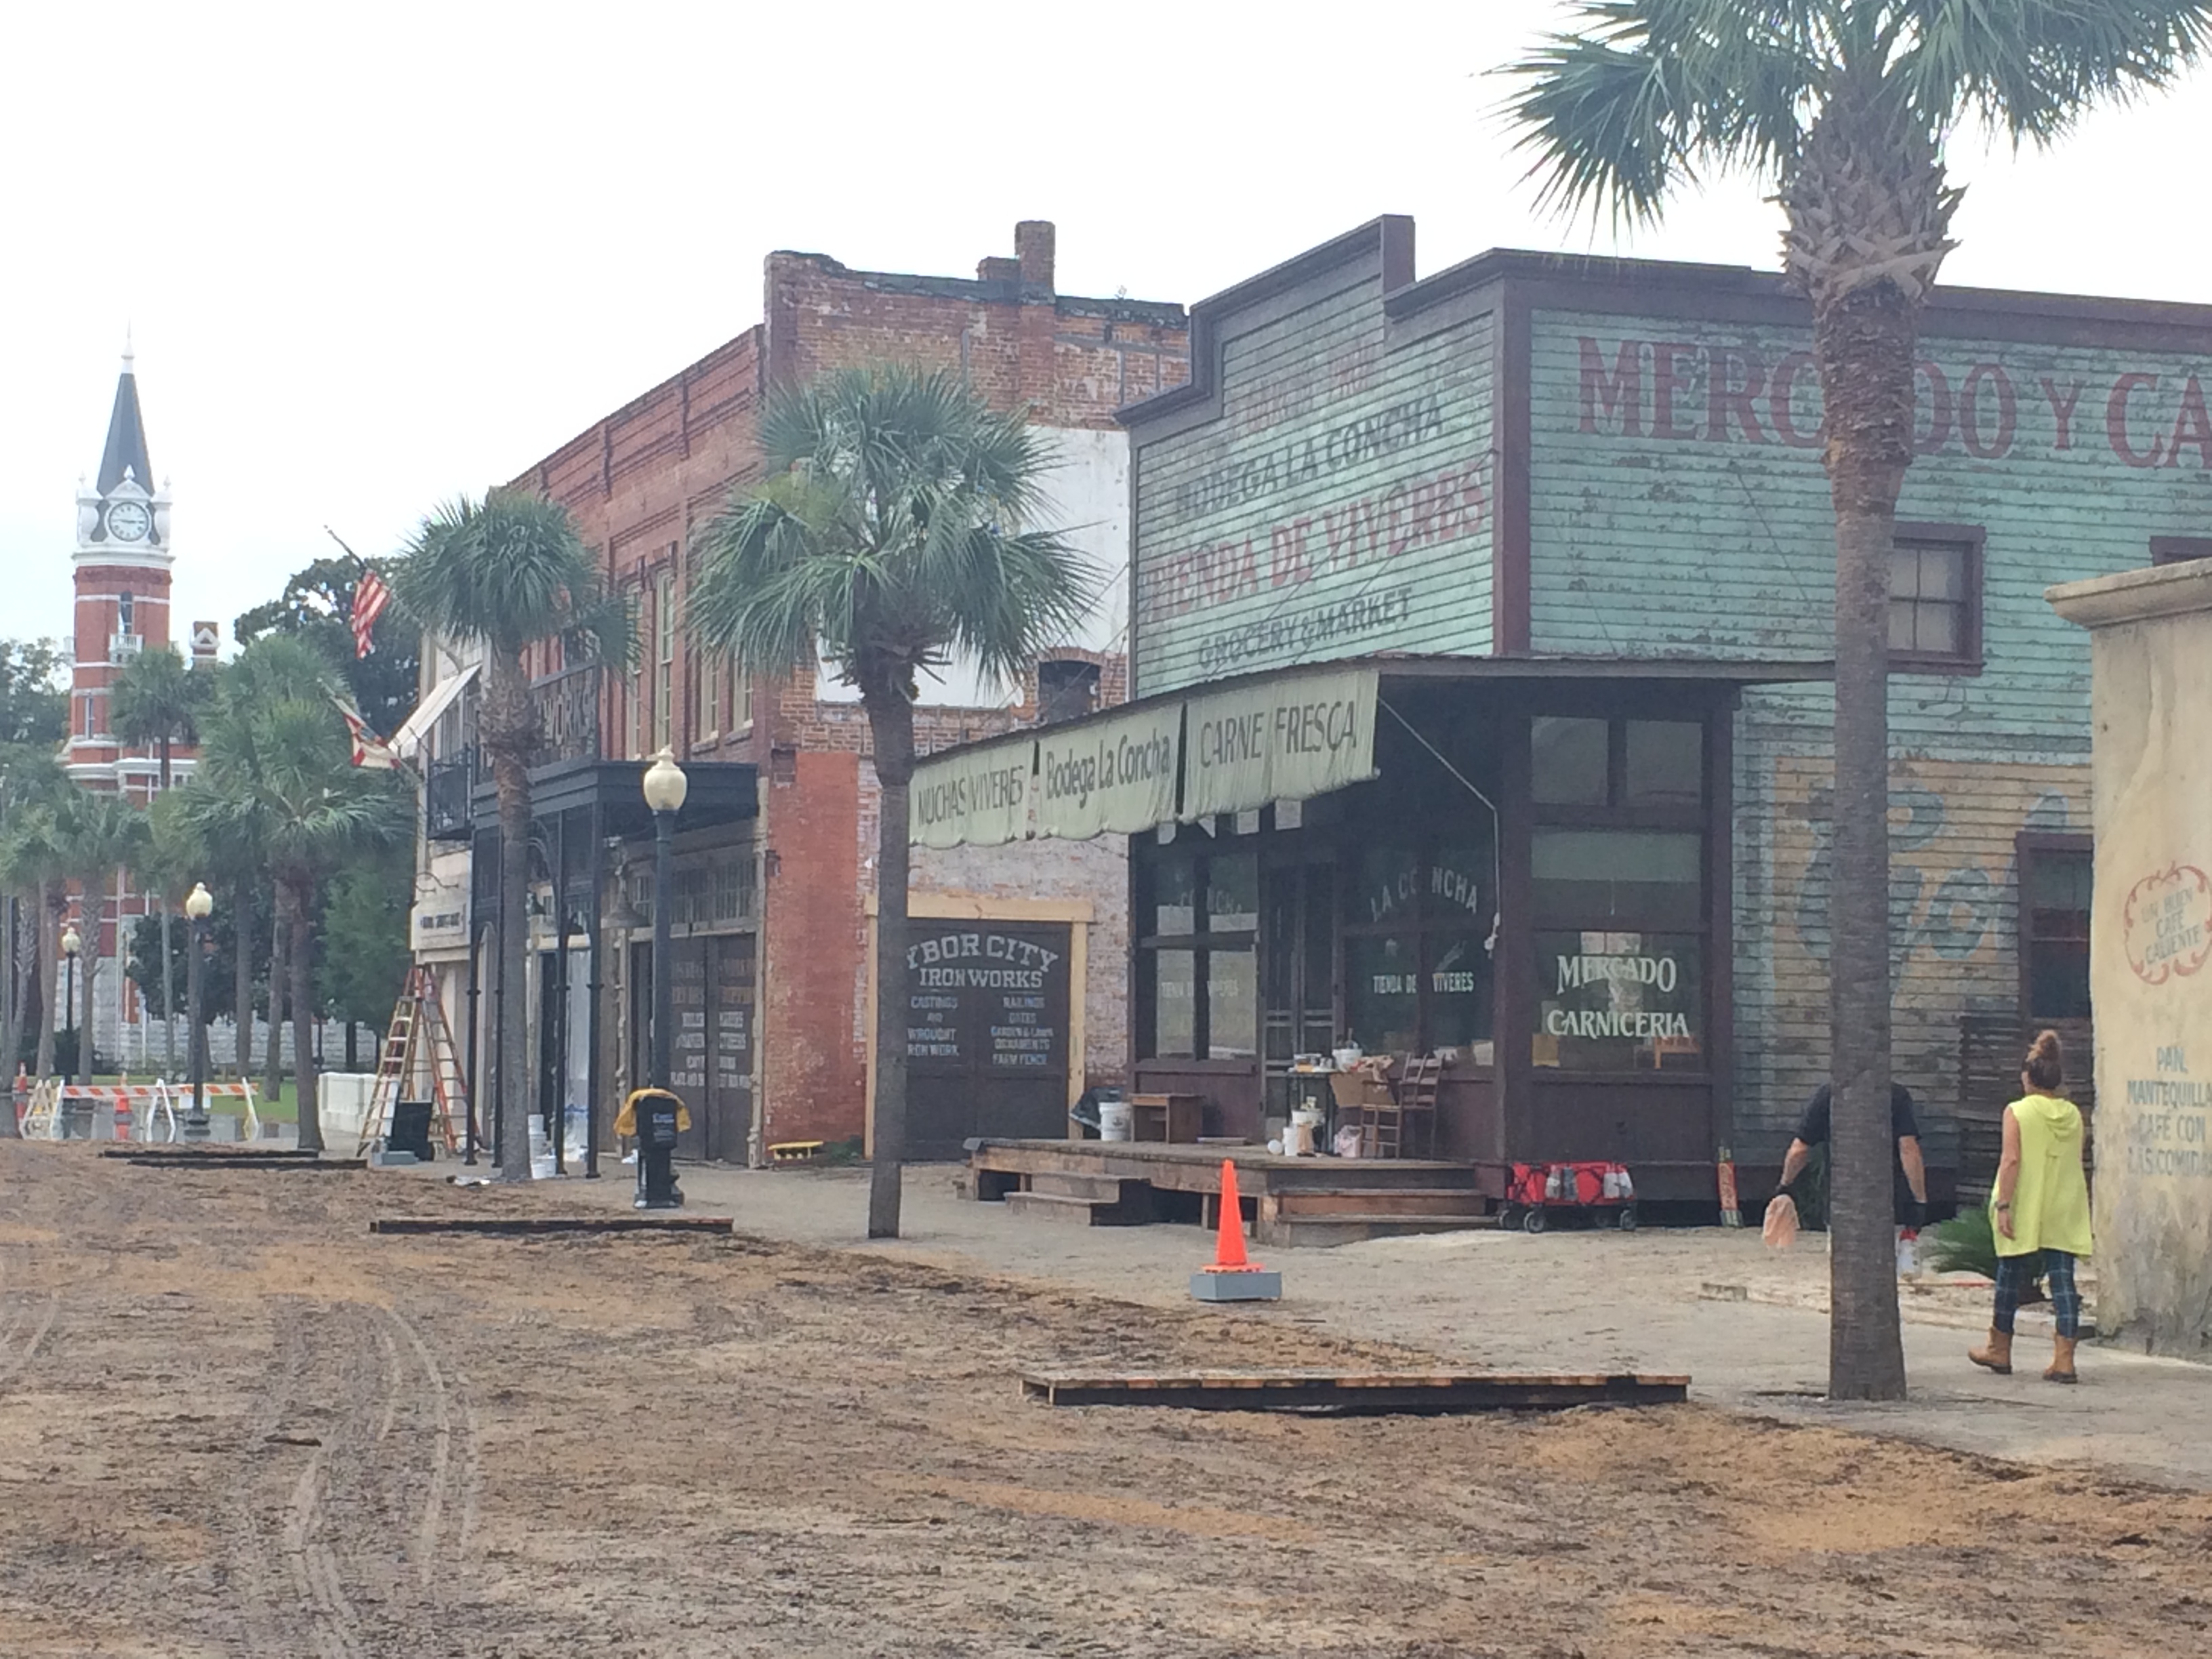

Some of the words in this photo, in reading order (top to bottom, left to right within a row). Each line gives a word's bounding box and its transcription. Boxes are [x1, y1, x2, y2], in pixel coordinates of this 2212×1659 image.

[1578, 337, 2017, 459] MERCDO
[2040, 377, 2086, 450] Y
[1271, 517, 1313, 587] DE
[1323, 462, 1486, 573] VIVERES
[1198, 617, 1297, 668] GROCERY
[1315, 588, 1412, 642] MARKET
[1200, 712, 1265, 769] CARNE
[1276, 701, 1357, 754] FRESCA
[1047, 748, 1095, 809] Bodega
[1099, 739, 1114, 796] La
[1119, 727, 1170, 786] Concha
[969, 765, 1024, 812] VIVERES
[1370, 885, 1392, 922] LA
[906, 933, 982, 969] YBOR
[987, 935, 1059, 972] CITY
[2146, 924, 2200, 964] CALIENTE
[920, 968, 965, 987] IRON
[967, 969, 1043, 988] WORKS
[1432, 972, 1474, 993] VIVERES
[1557, 955, 1677, 995] MERCADO
[1548, 1010, 1689, 1040] CARNICERIA
[2177, 1115, 2206, 1143] CON
